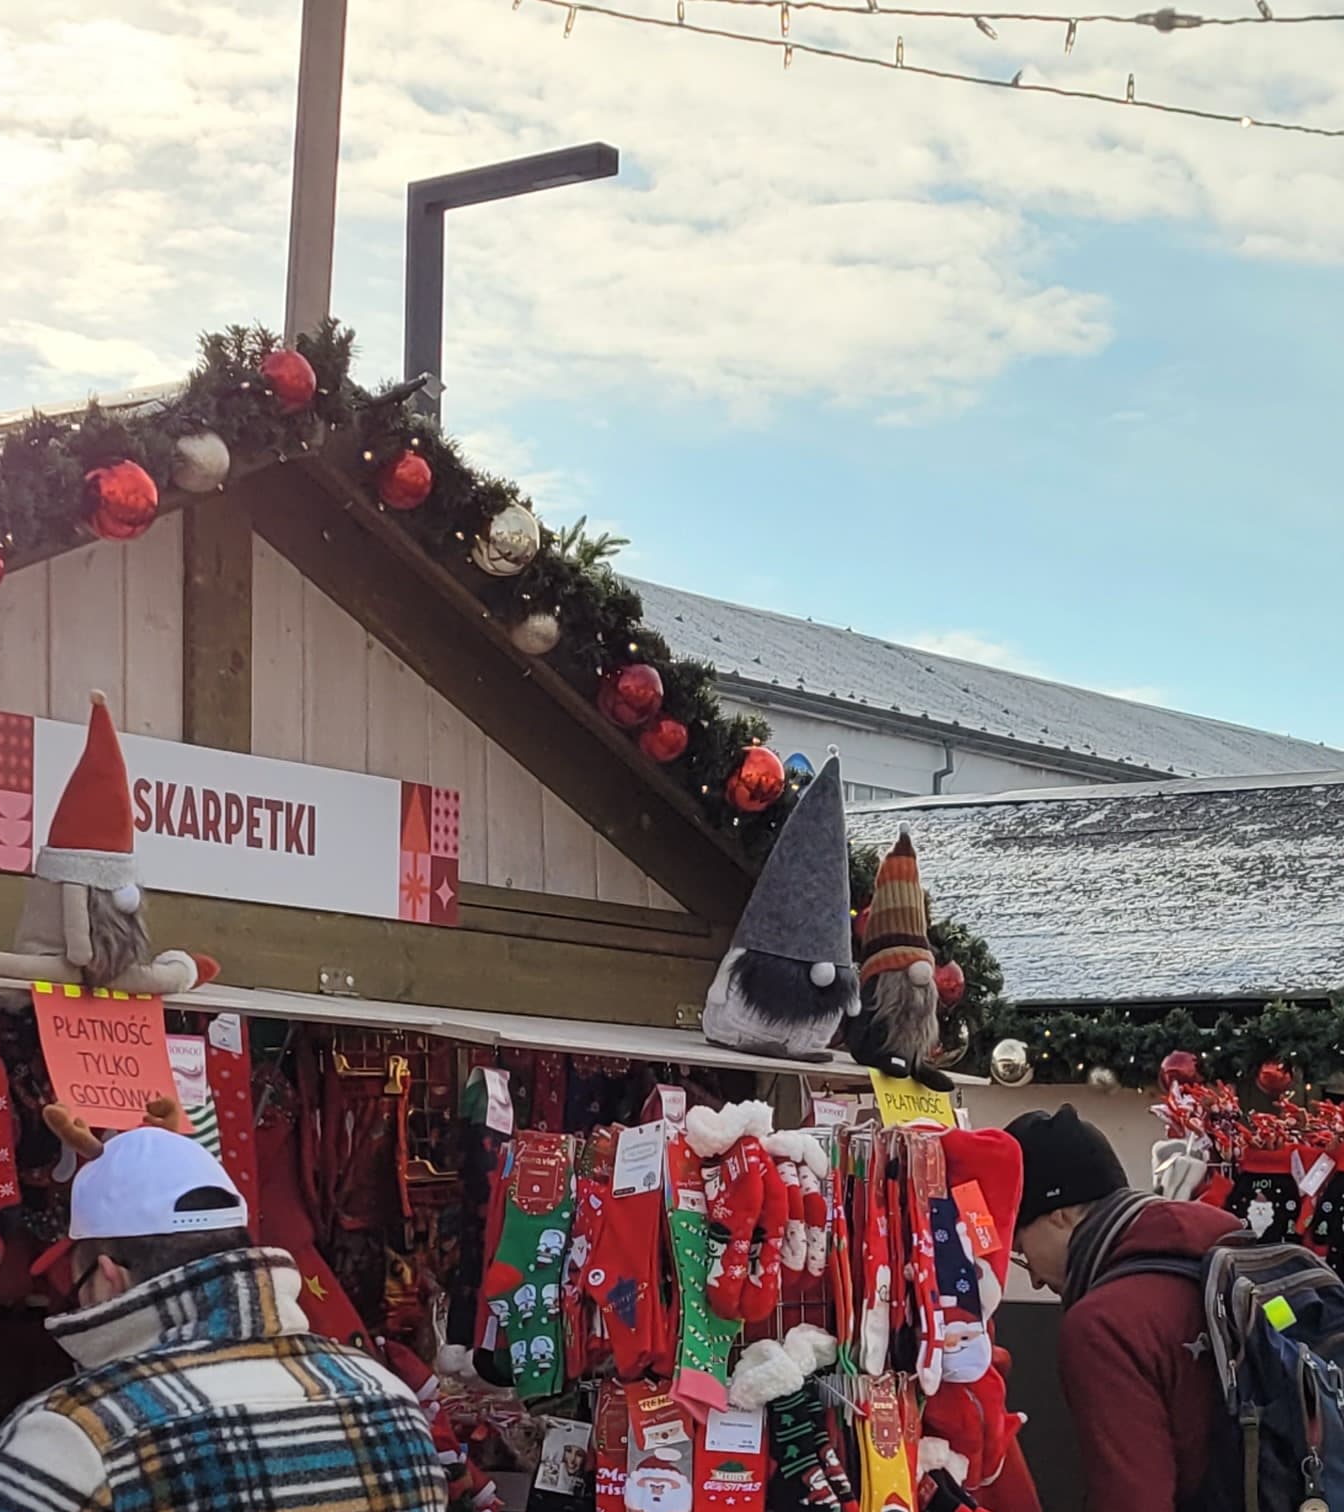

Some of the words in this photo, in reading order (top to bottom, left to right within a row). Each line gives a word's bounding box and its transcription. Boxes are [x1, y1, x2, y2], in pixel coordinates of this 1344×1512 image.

[134, 777, 317, 857] SKARPETKI
[53, 1015, 153, 1047] PŁATNOŚĆ
[77, 1051, 140, 1078] TYLKO
[884, 1091, 946, 1115] PŁATNOŚĆ
